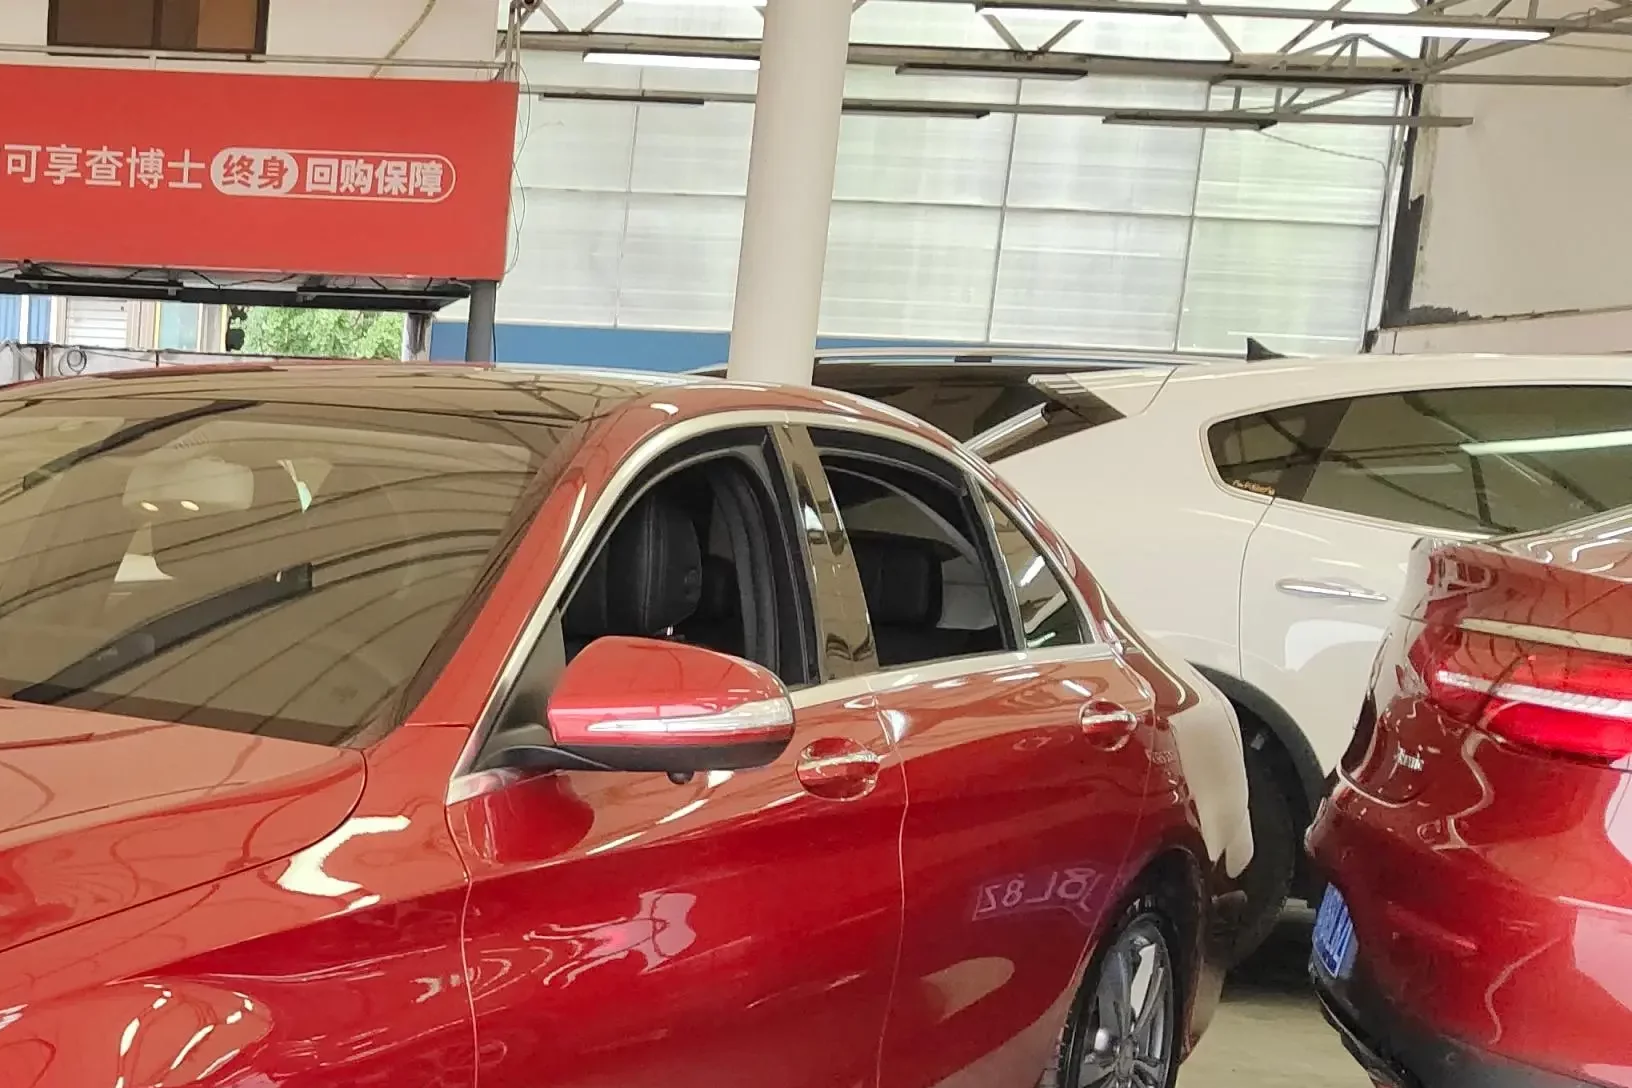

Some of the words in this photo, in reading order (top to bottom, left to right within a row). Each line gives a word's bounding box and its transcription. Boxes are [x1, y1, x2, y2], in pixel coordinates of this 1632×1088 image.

[221, 152, 291, 191] 终身
[305, 156, 445, 197] 回购保障
